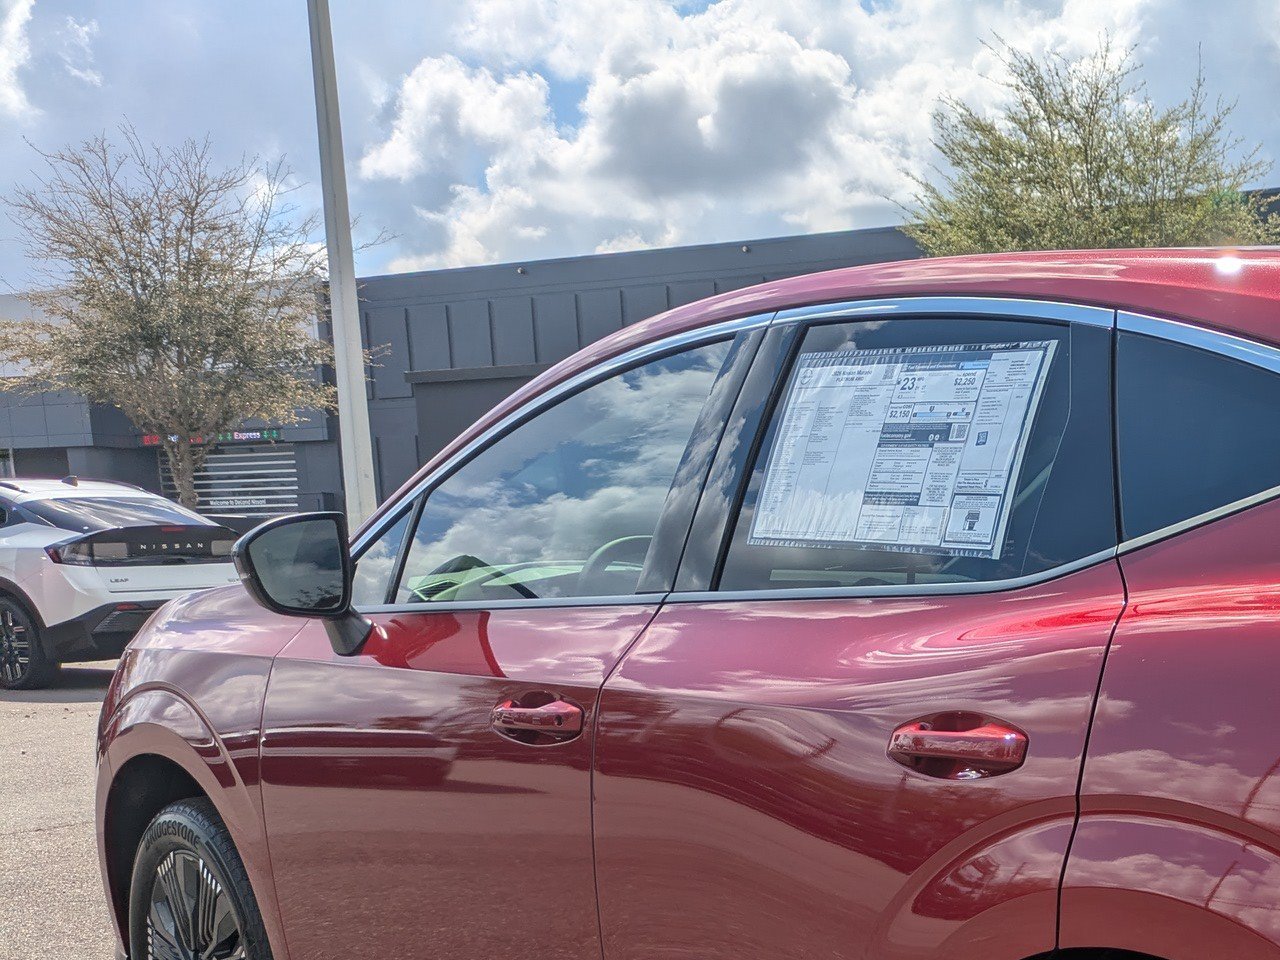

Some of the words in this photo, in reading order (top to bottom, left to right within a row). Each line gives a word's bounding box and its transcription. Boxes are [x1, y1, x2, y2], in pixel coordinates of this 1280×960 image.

[900, 377, 916, 391] 23
[954, 377, 976, 387] $2,250
[889, 411, 910, 419] $2,150
[234, 431, 261, 440] Express
[145, 819, 201, 851] BRIDGESTONE
